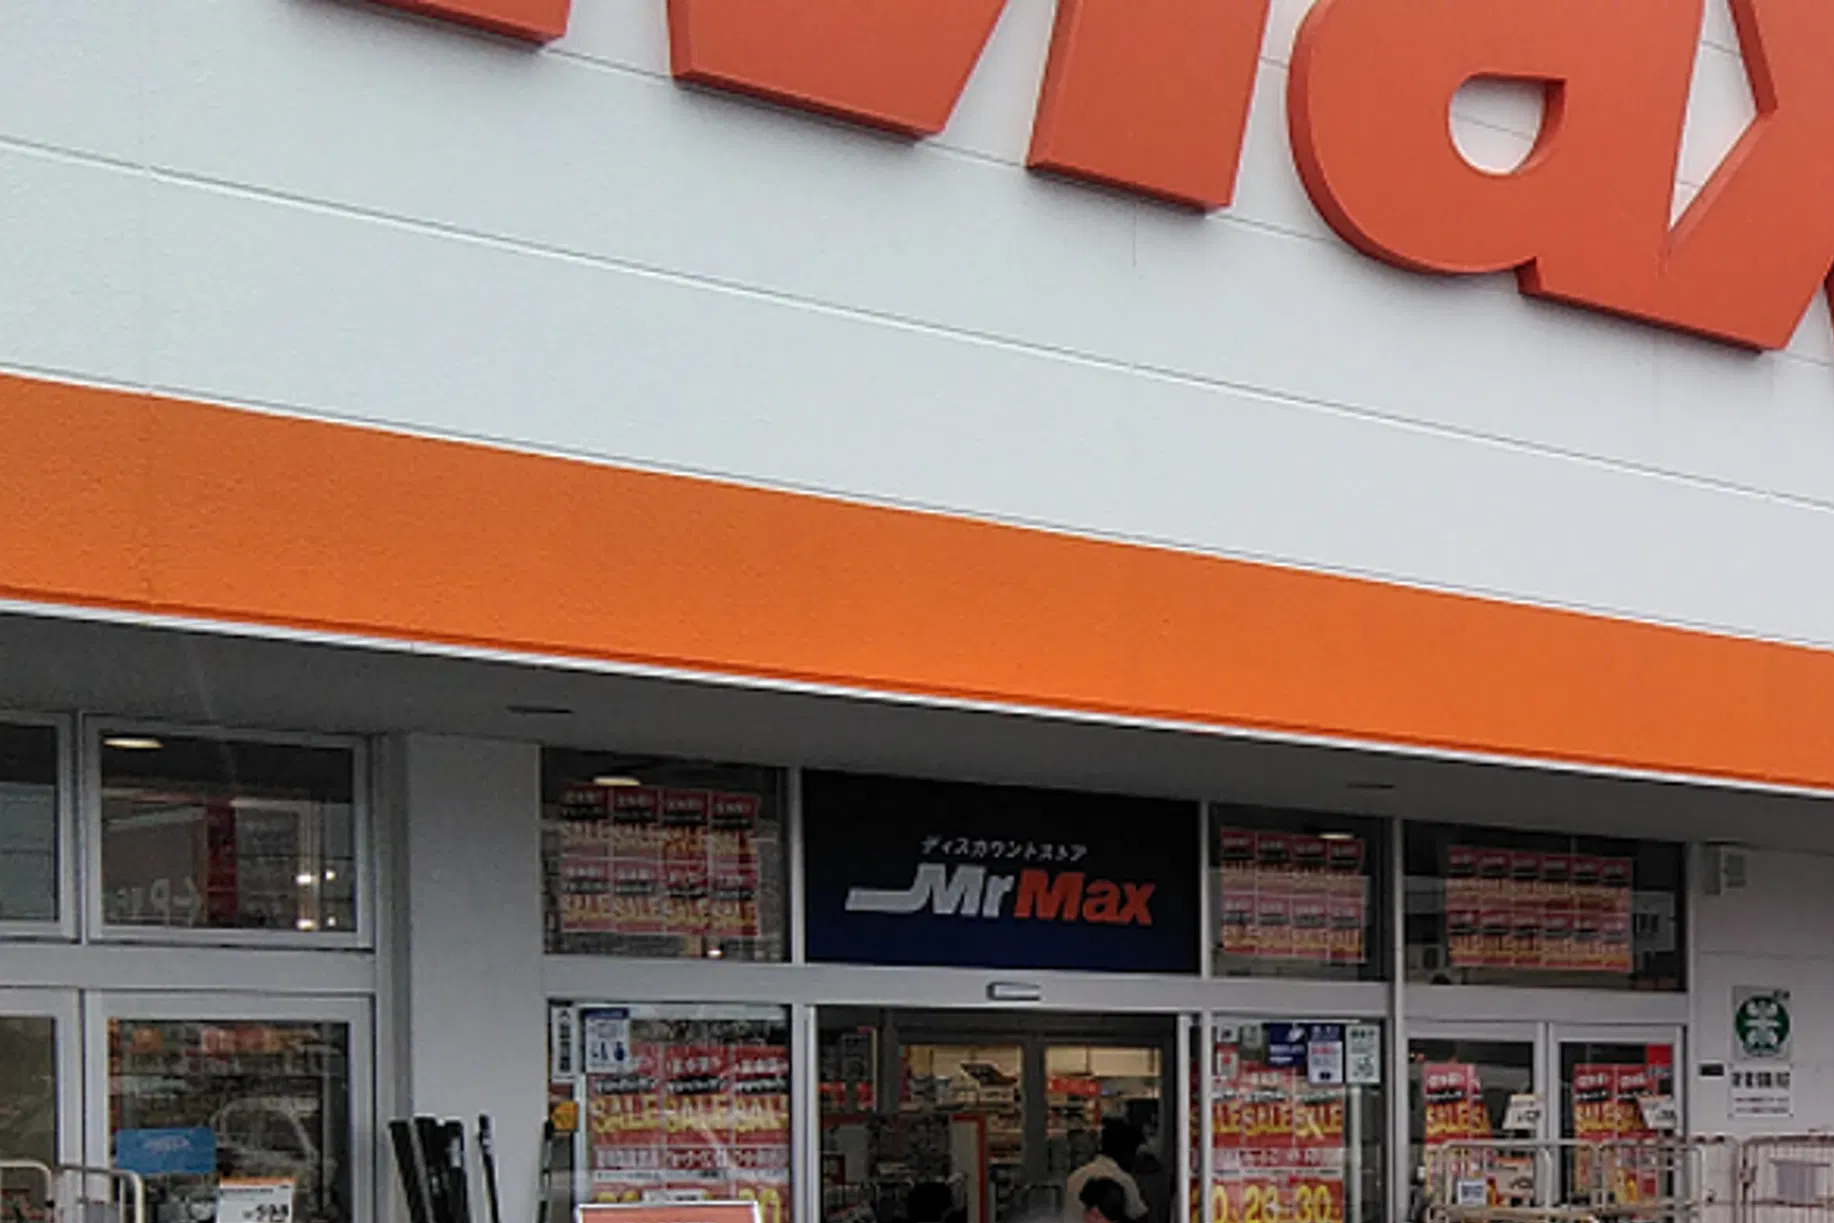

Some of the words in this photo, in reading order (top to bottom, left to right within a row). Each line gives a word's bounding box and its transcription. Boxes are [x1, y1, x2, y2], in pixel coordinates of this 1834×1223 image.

[920, 835, 1088, 862] ディスカウントストア
[592, 1094, 660, 1133] SALE
[664, 1094, 730, 1133] SALE
[1241, 1103, 1292, 1135] SALE
[1295, 1103, 1343, 1137] SALE
